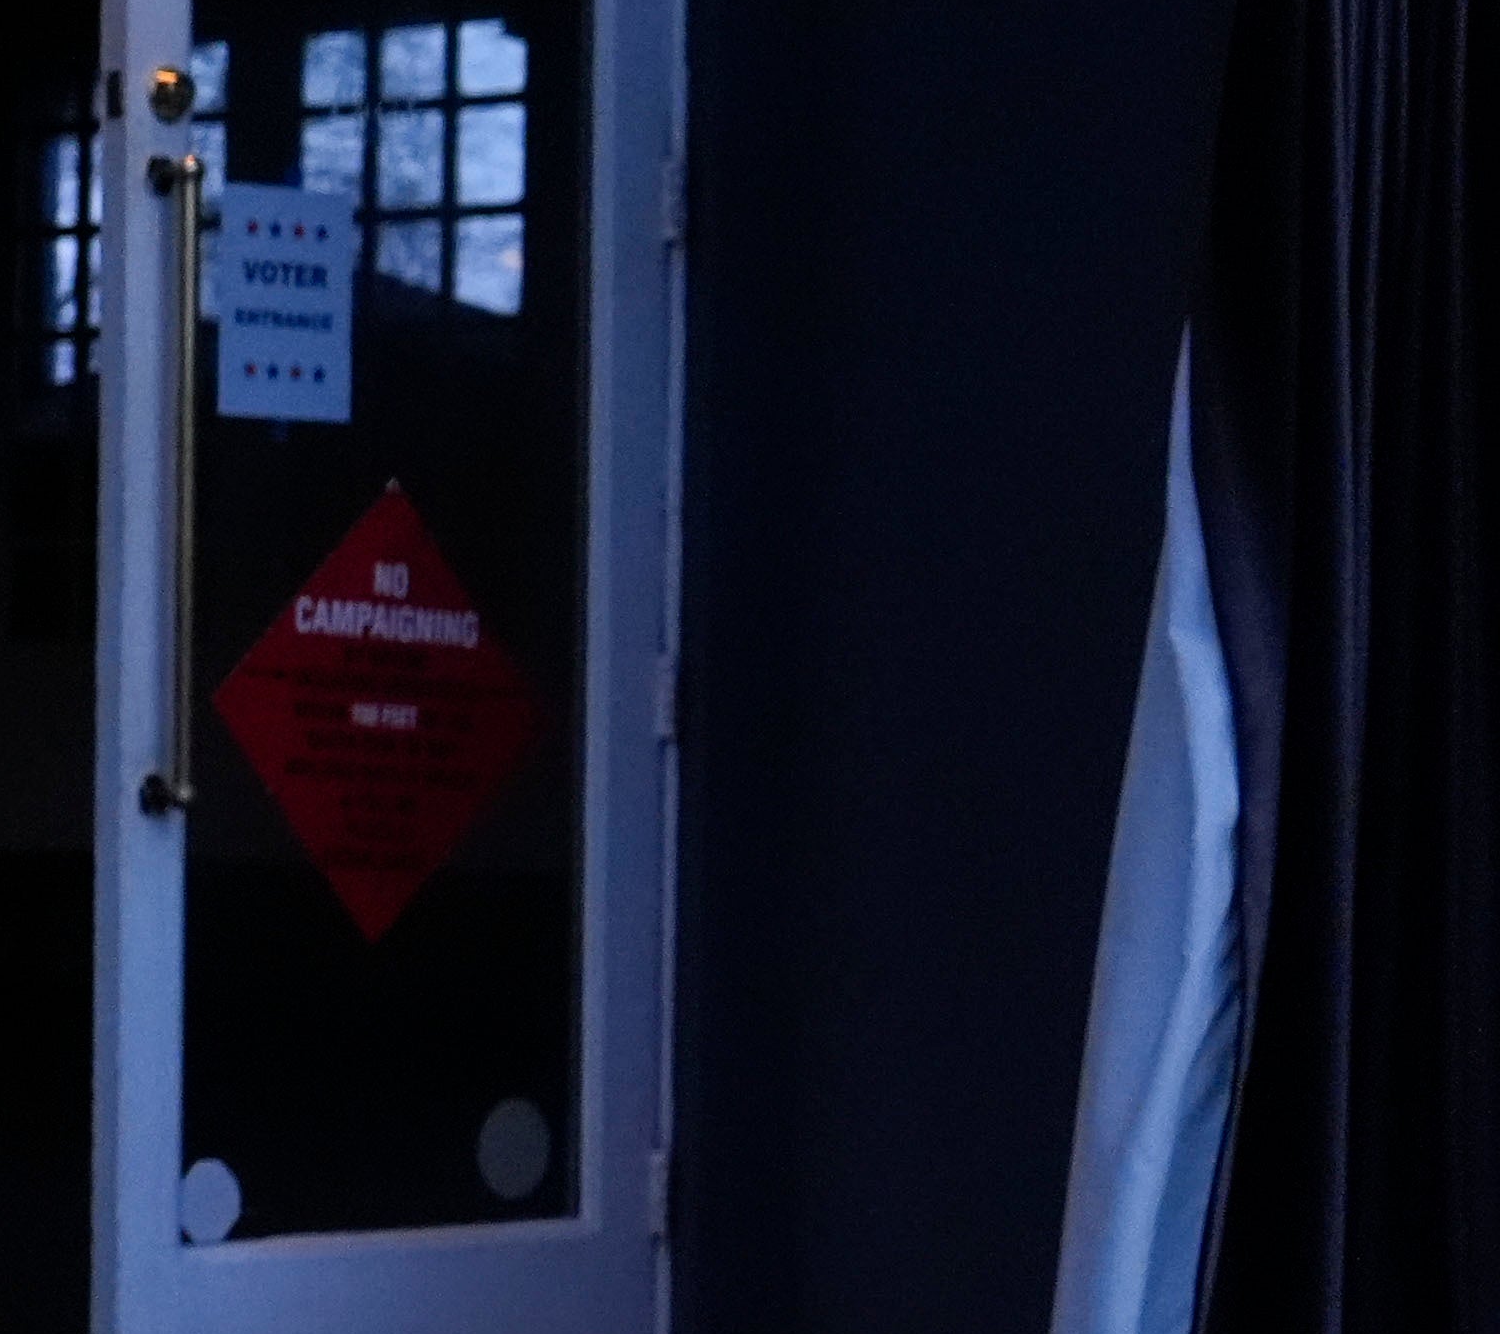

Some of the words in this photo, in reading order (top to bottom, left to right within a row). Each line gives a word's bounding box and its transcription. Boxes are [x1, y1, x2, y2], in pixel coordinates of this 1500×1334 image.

[243, 261, 328, 288] VOTER
[373, 561, 410, 600] NO
[294, 595, 480, 650] CAMPAIGNING
